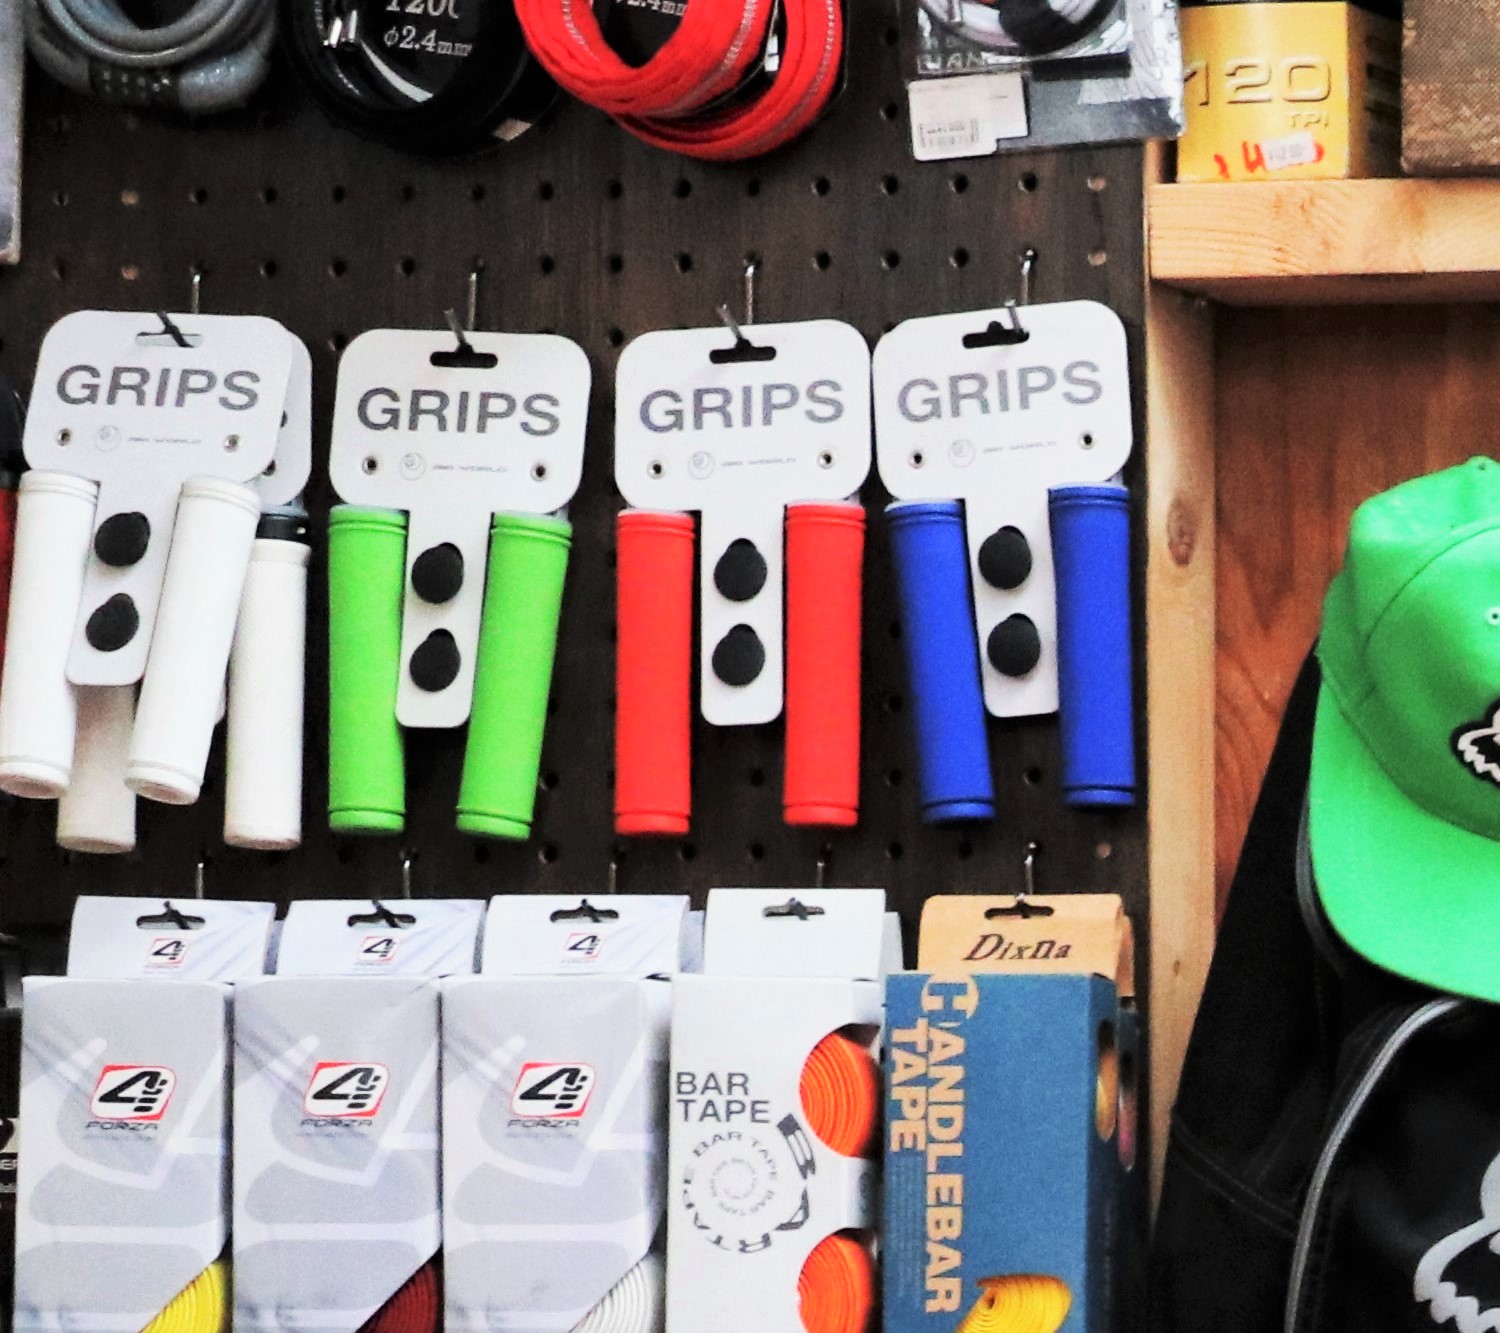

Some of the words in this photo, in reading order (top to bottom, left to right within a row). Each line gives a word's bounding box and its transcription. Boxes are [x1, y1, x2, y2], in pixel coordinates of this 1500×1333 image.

[1184, 57, 1332, 106] 120
[56, 364, 260, 411] GRIPS
[357, 387, 560, 436] GRIPS
[640, 379, 845, 433] GRIPS
[900, 360, 1102, 424] GRIPS
[676, 1072, 750, 1096] BAR
[890, 1018, 927, 1153] TAPE
[85, 1119, 158, 1130] FORZA
[300, 1117, 373, 1128] FORZA
[507, 1118, 579, 1129] FORZA
[677, 1099, 770, 1124] TAPE
[924, 972, 979, 1314] HANDLEBAR
